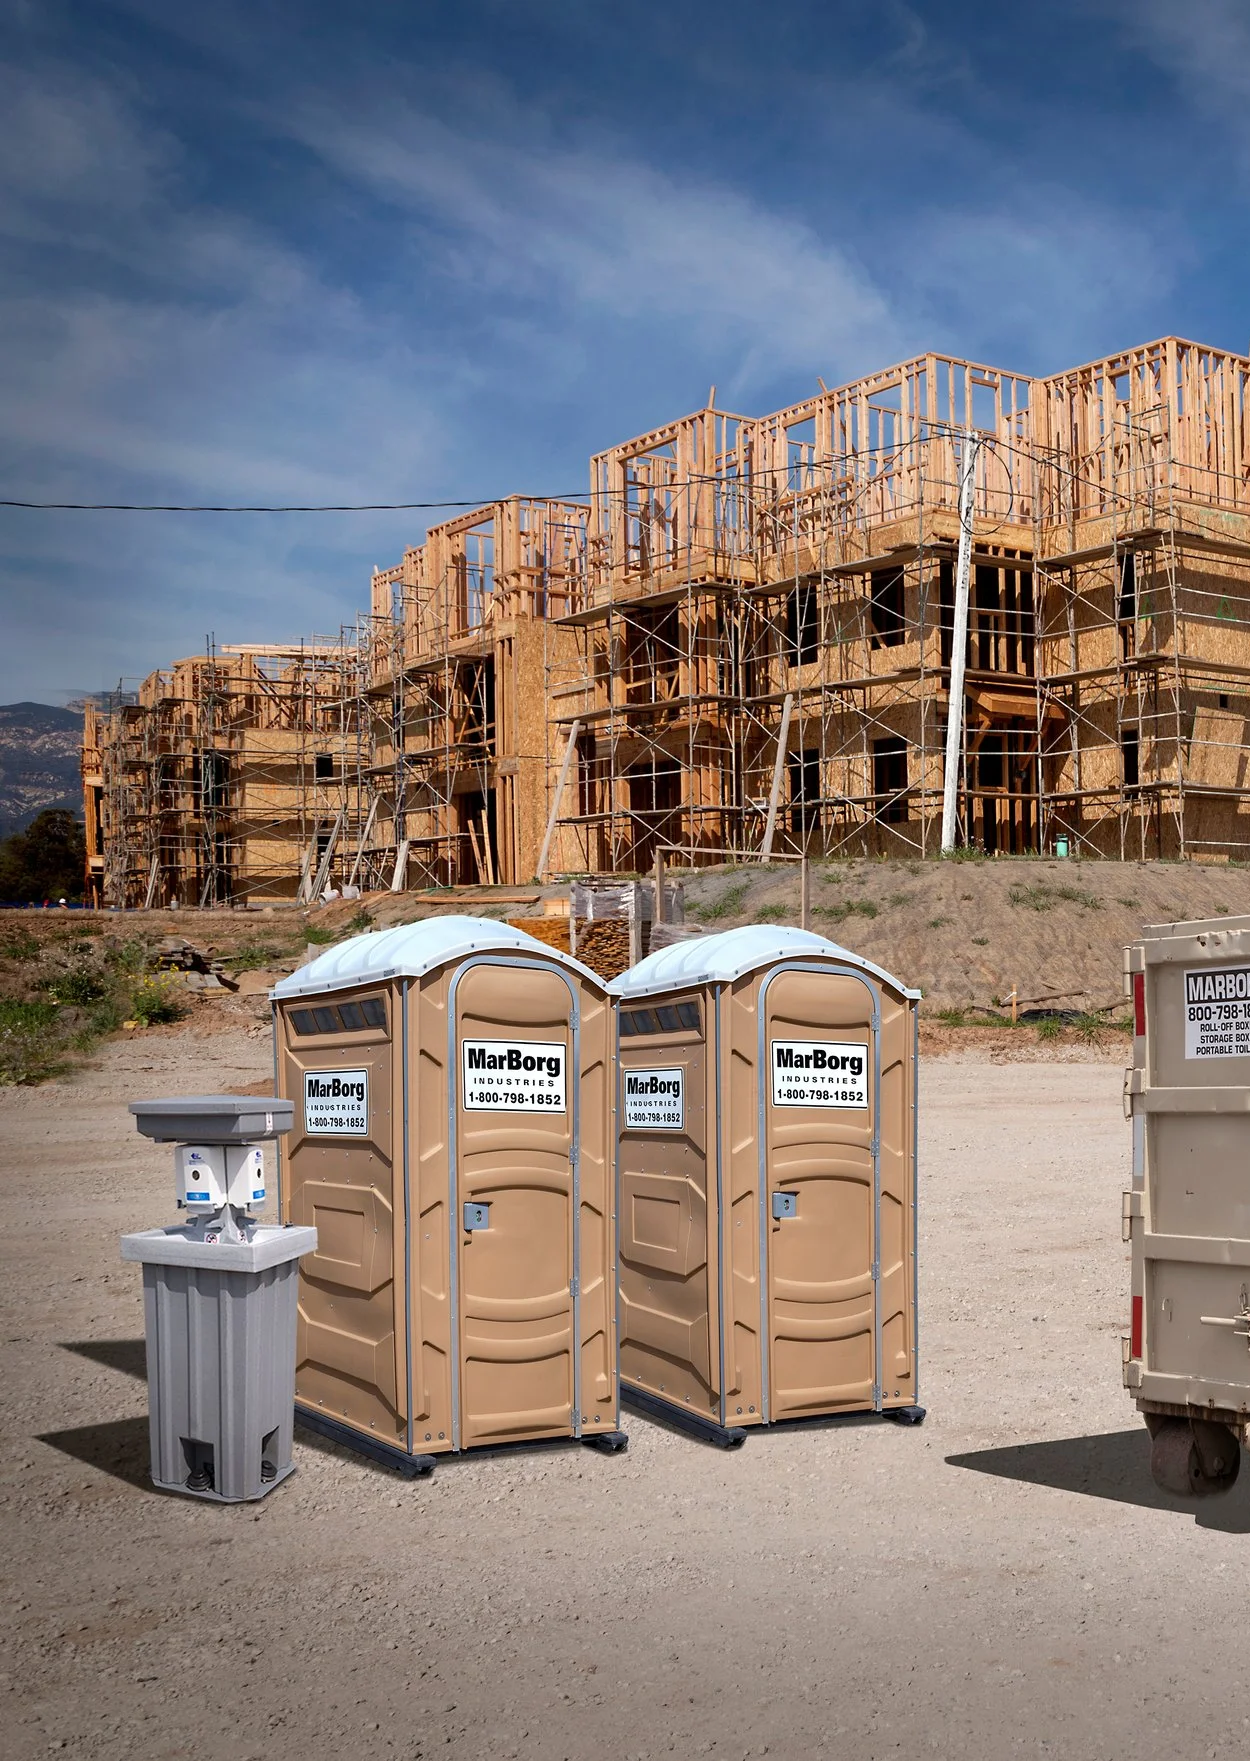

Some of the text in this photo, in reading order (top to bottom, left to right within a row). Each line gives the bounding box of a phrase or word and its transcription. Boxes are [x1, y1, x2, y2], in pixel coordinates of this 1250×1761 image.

[1200, 1022, 1233, 1032] ROLL-OFF
[1200, 1033, 1233, 1044] STORAGE
[1196, 1045, 1233, 1055] PORTABLE
[468, 1047, 561, 1078] MarBorg
[776, 1047, 863, 1076] MarBorg
[473, 1077, 555, 1087] INDUSTRIES
[782, 1075, 857, 1085] INDUSTRIES
[308, 1078, 364, 1102] MarBorg
[627, 1076, 680, 1098] MarBorg
[468, 1091, 561, 1105] 1-800-798-1852
[777, 1088, 864, 1102] 1-800-798-1852
[308, 1116, 365, 1128] 1-800-798-1852
[628, 1112, 681, 1123] 1-800-798-1852
